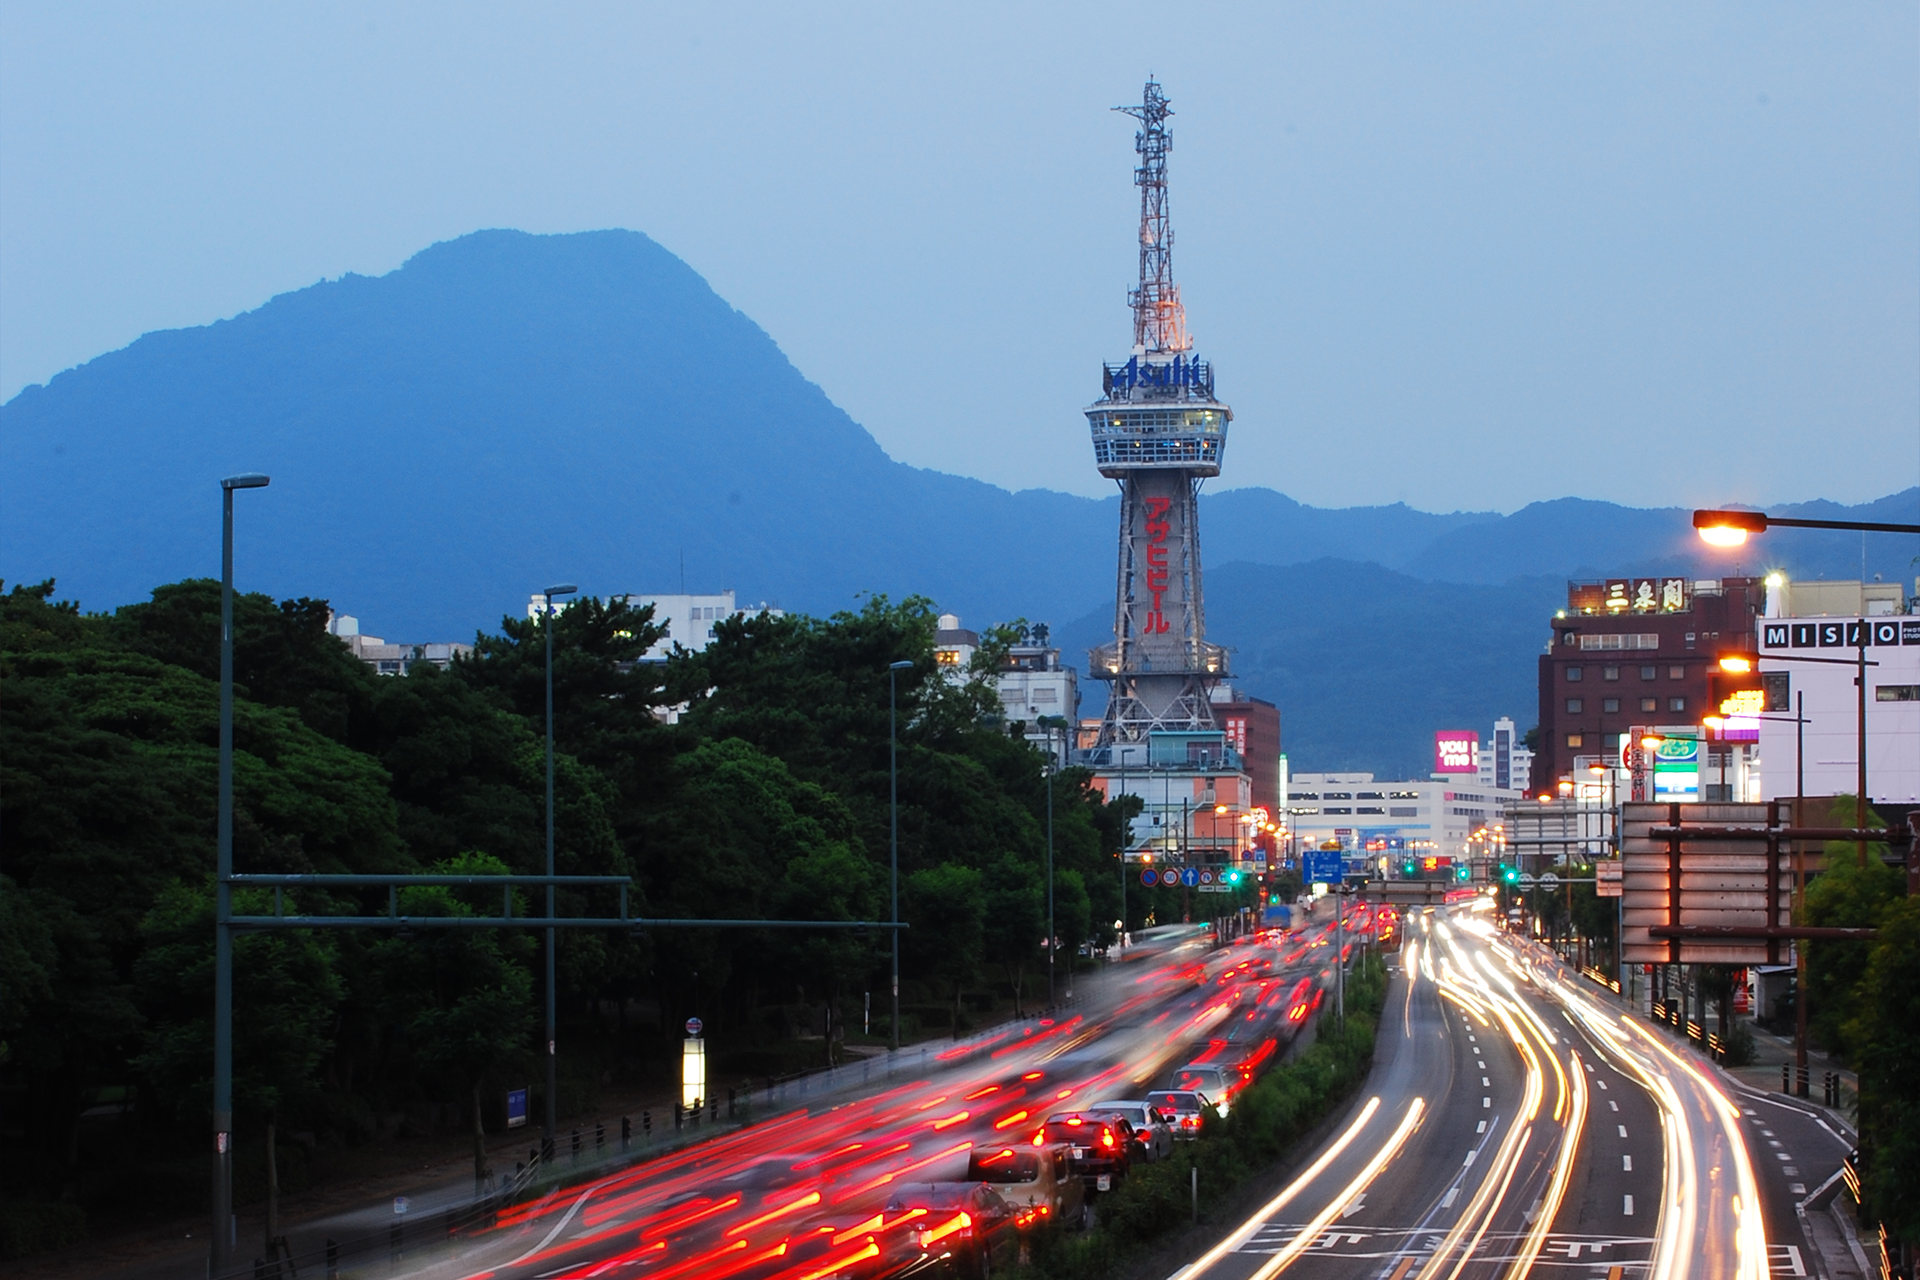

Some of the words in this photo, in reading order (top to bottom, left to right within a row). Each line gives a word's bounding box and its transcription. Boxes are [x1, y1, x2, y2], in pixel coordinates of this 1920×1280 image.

[1113, 353, 1200, 389] Asahi
[1144, 497, 1170, 635] アサヒビール
[1438, 740, 1468, 758] you
[1444, 753, 1470, 766] me
[1165, 873, 1176, 882] 50
